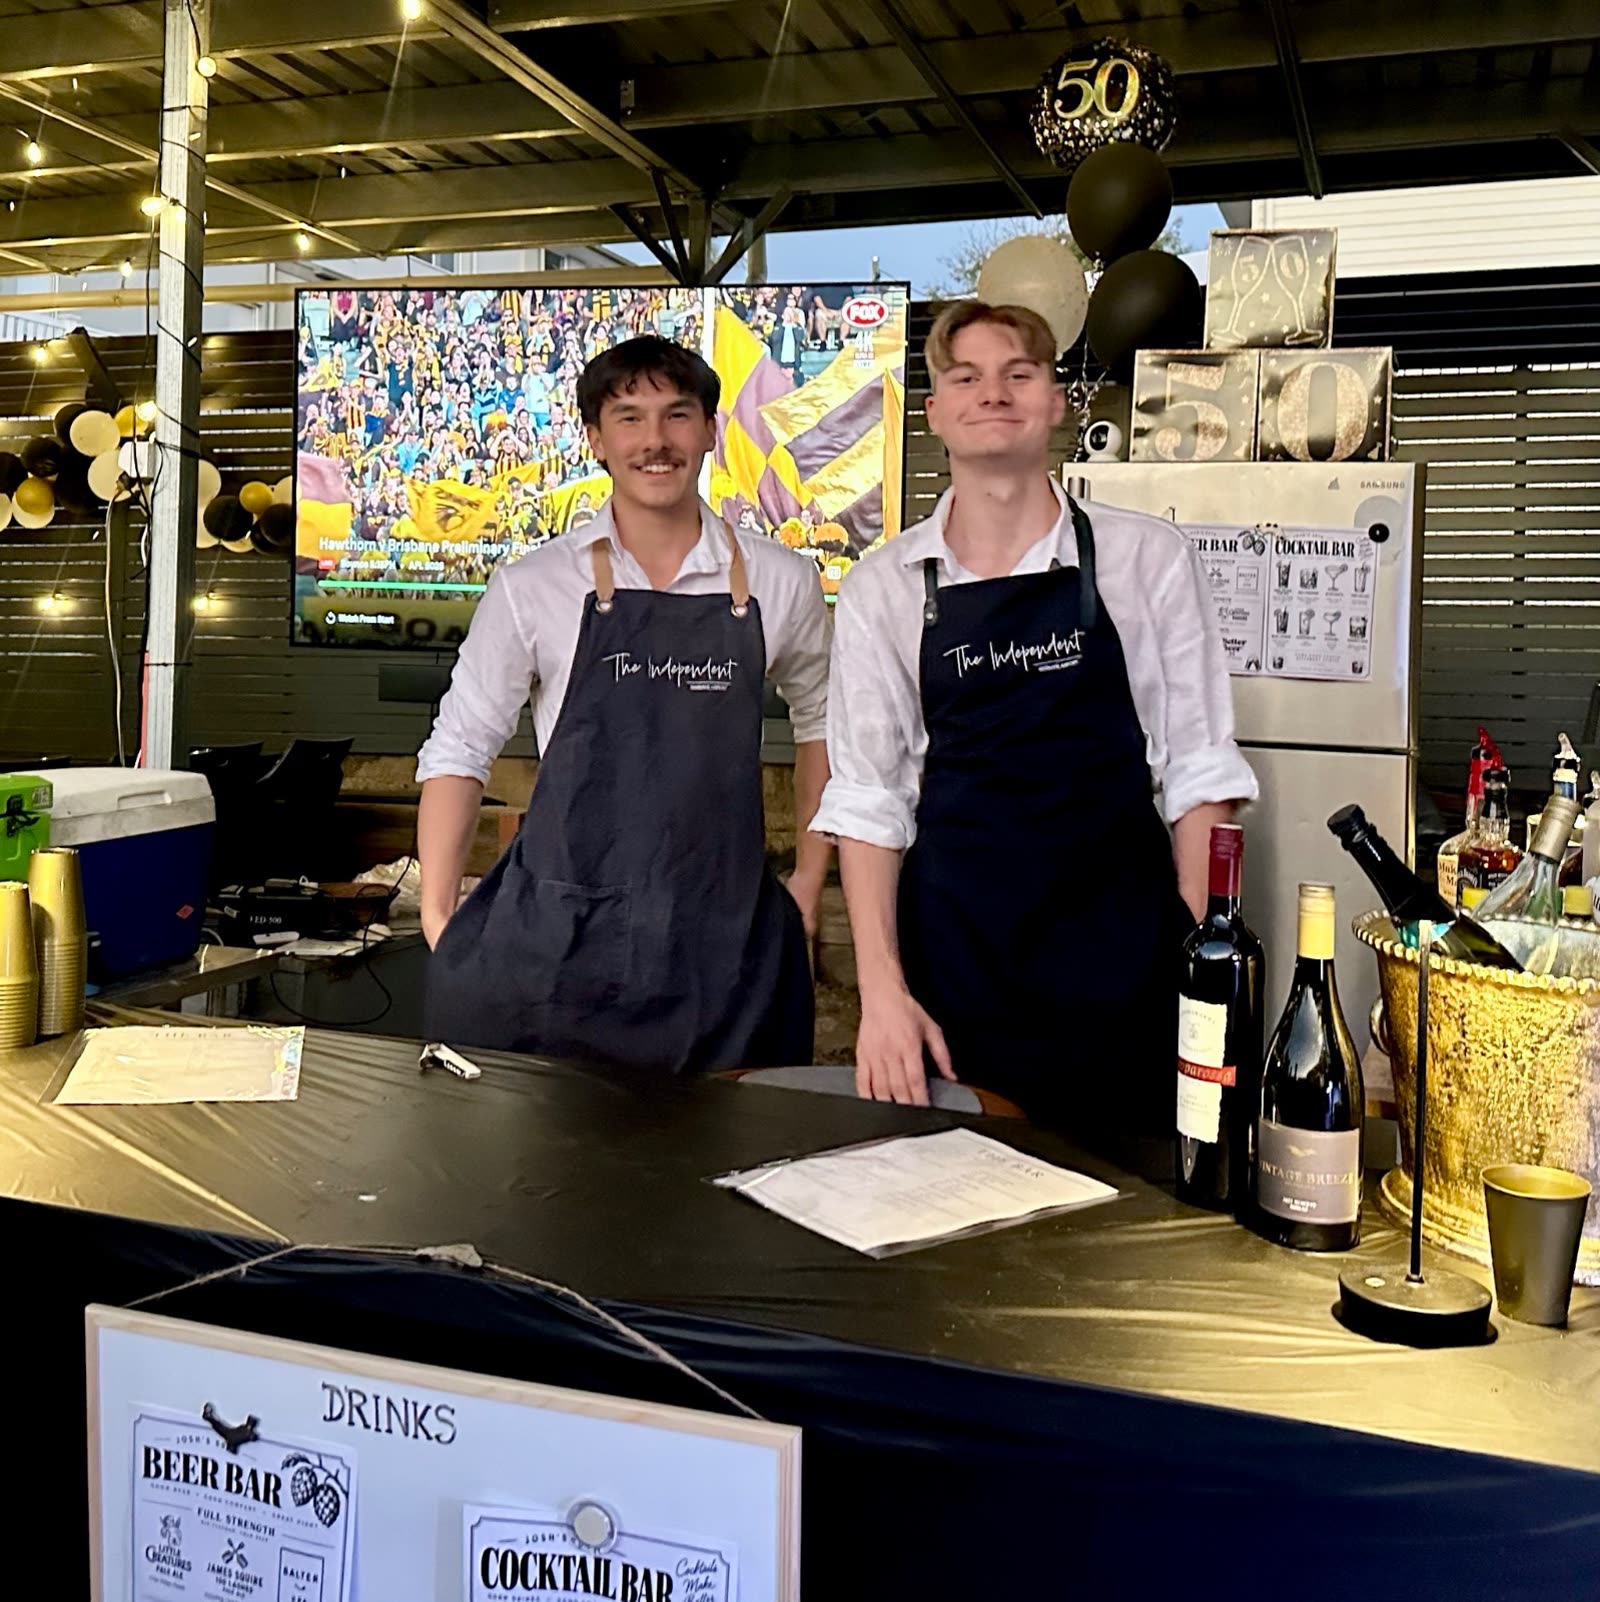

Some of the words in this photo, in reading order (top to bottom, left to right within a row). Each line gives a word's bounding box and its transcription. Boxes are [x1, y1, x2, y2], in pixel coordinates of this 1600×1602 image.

[1054, 58, 1140, 119] 50
[849, 304, 881, 321] FOX
[1360, 480, 1406, 489] SAMSUNG
[319, 537, 377, 552] Hawthorn
[379, 542, 387, 552] v
[388, 539, 440, 554] Brisbane
[441, 540, 510, 557] Preliminary
[1210, 539, 1238, 553] BAR
[1275, 539, 1330, 556] COCKTAIL
[1331, 541, 1355, 558] BAR
[338, 613, 359, 623] Watch
[377, 614, 395, 625] Start
[943, 644, 984, 679] The
[989, 628, 1086, 672] Independent
[600, 652, 642, 683] The
[647, 655, 738, 689] Independent
[321, 1381, 457, 1445] DRINKS
[142, 1445, 219, 1490] BEER
[224, 1462, 282, 1509] BAR
[197, 1506, 224, 1523] FULL
[225, 1513, 276, 1538] STRENGTH
[525, 1532, 567, 1544] JOSH'S
[145, 1544, 192, 1572] CREATURES
[158, 1543, 181, 1557] LITTLE
[207, 1562, 234, 1579] JAMES
[234, 1568, 264, 1588] SQUIRE
[282, 1565, 319, 1584] BALTER
[480, 1546, 618, 1602] COCKTAIL
[621, 1562, 674, 1602] BAR
[675, 1557, 718, 1578] Cocktails
[683, 1575, 716, 1594] Make
